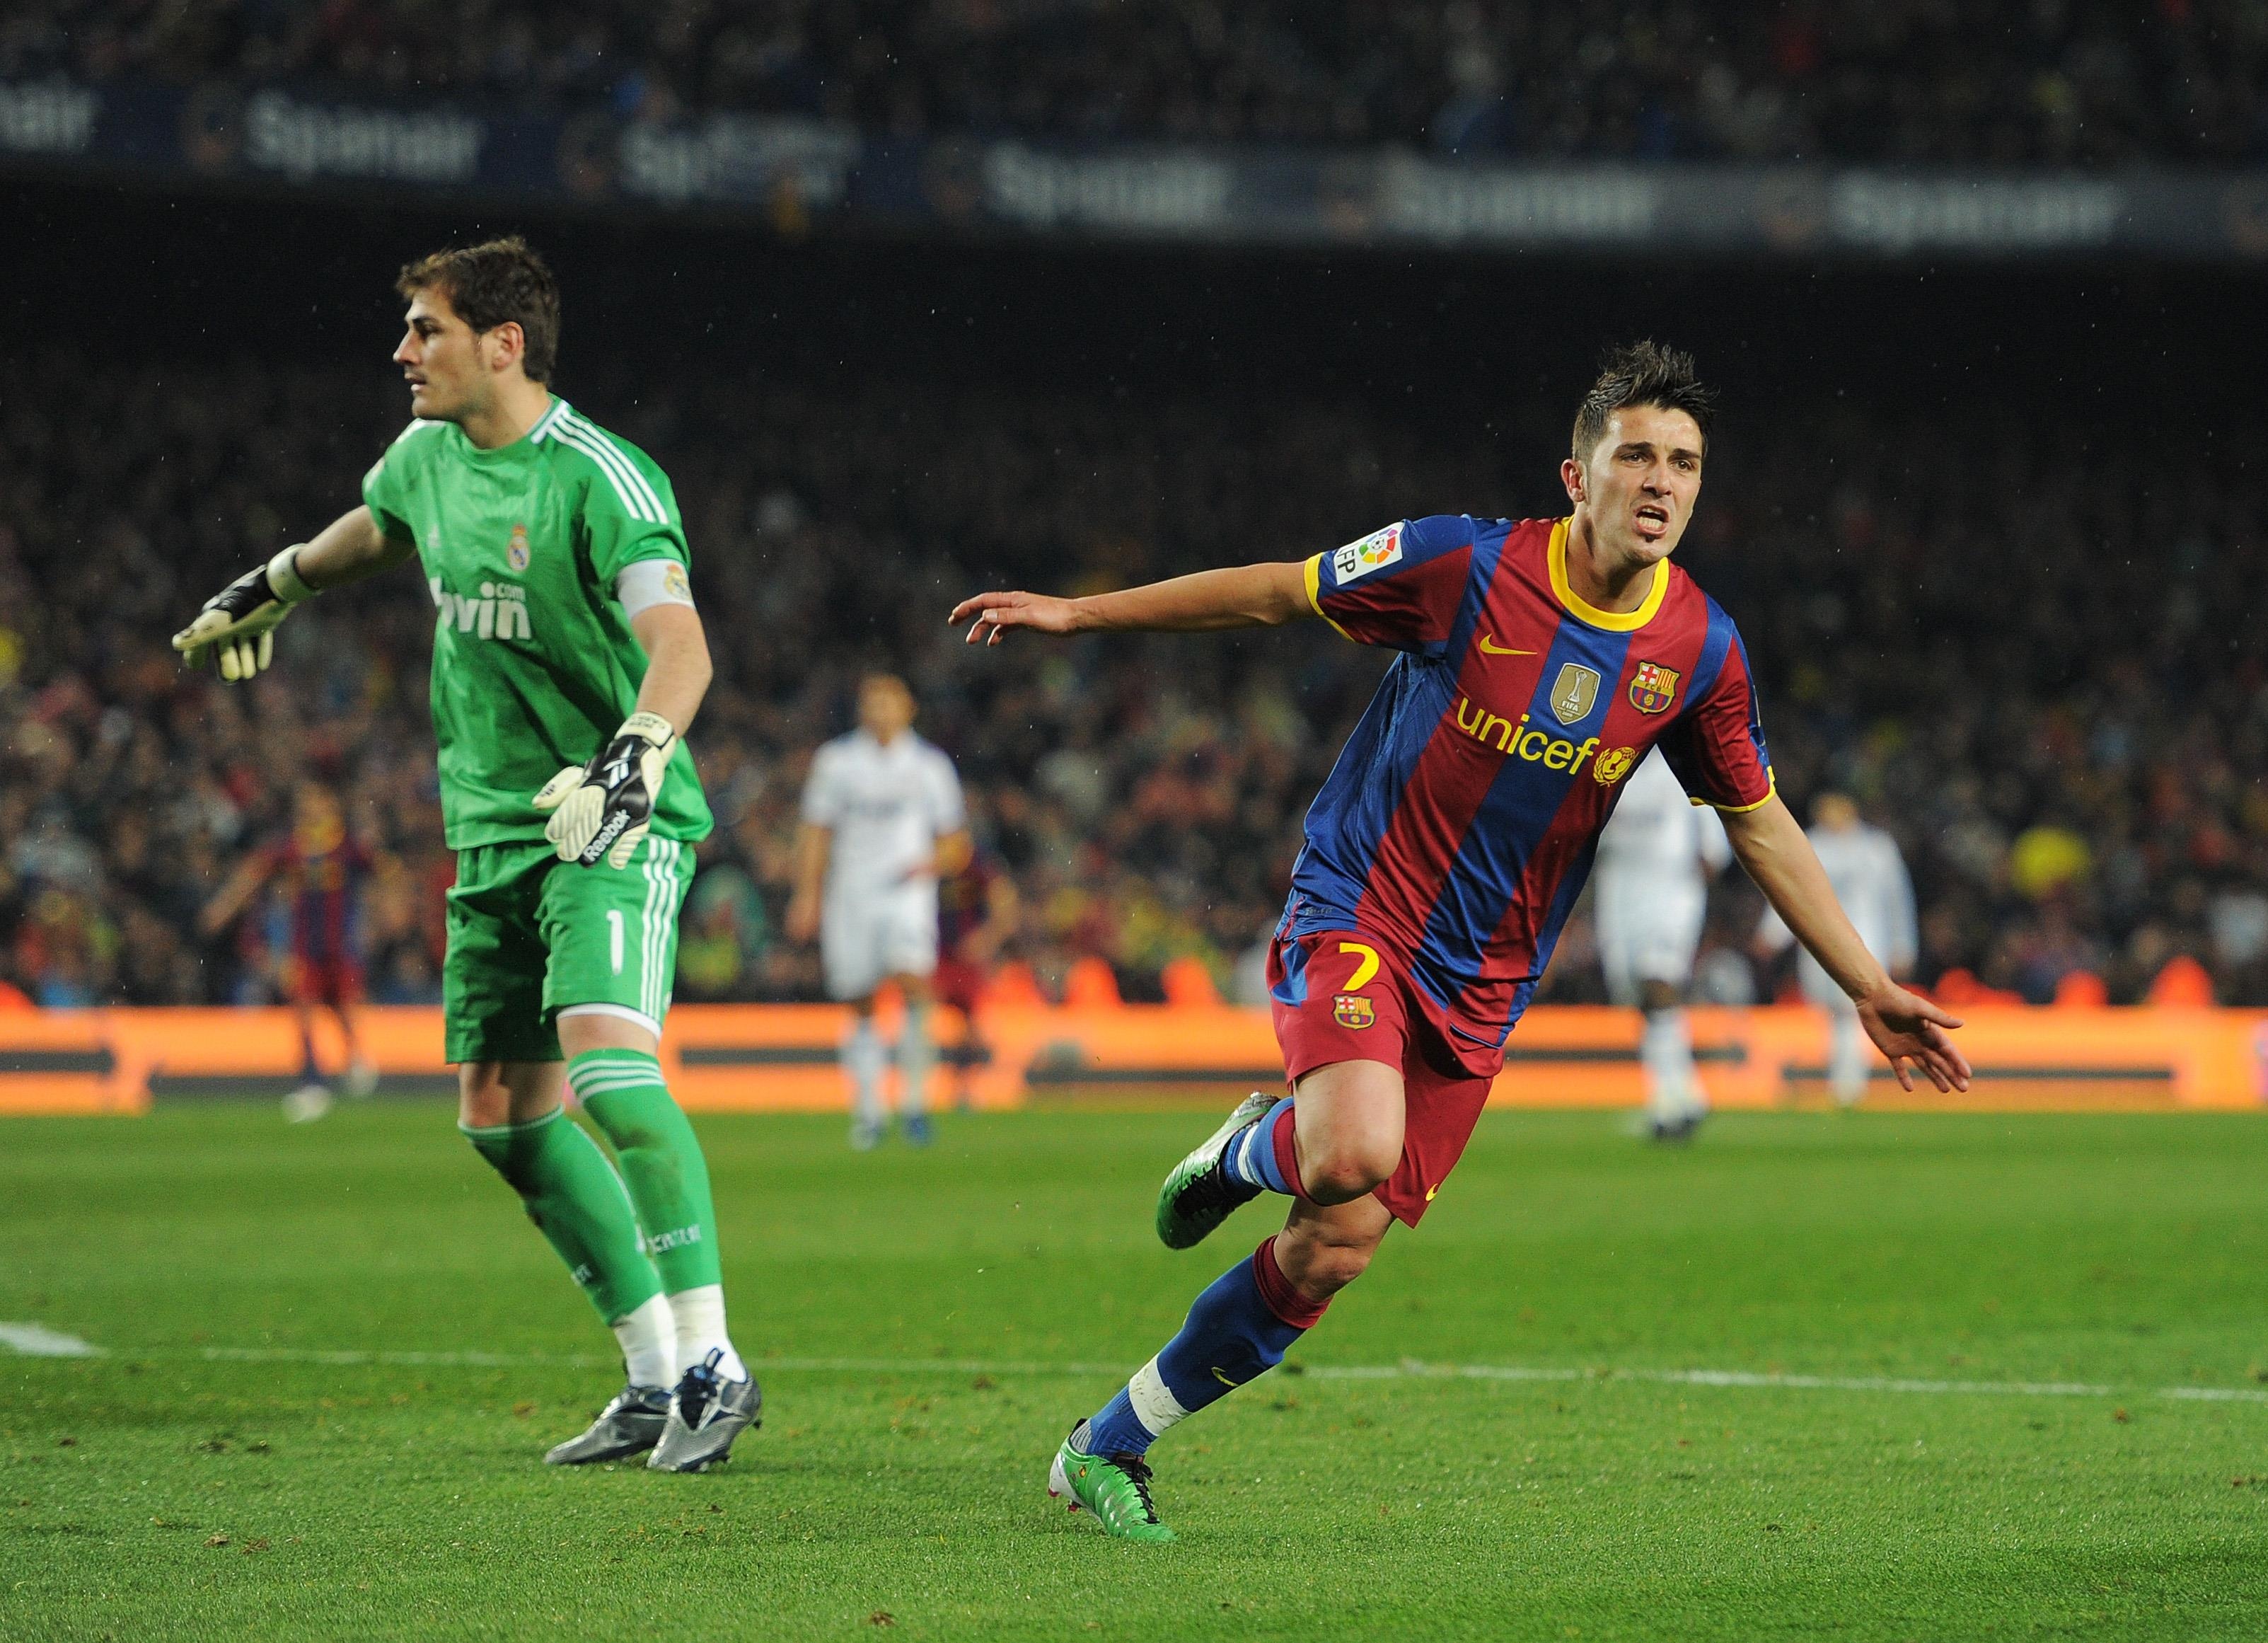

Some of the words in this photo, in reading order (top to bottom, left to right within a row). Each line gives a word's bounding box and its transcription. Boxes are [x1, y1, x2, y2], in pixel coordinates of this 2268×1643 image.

[1561, 700, 1579, 712] FIFA
[1457, 697, 1600, 775] unicef
[582, 809, 631, 862] Reebok
[606, 910, 625, 976] 1
[1339, 942, 1379, 991] 7
